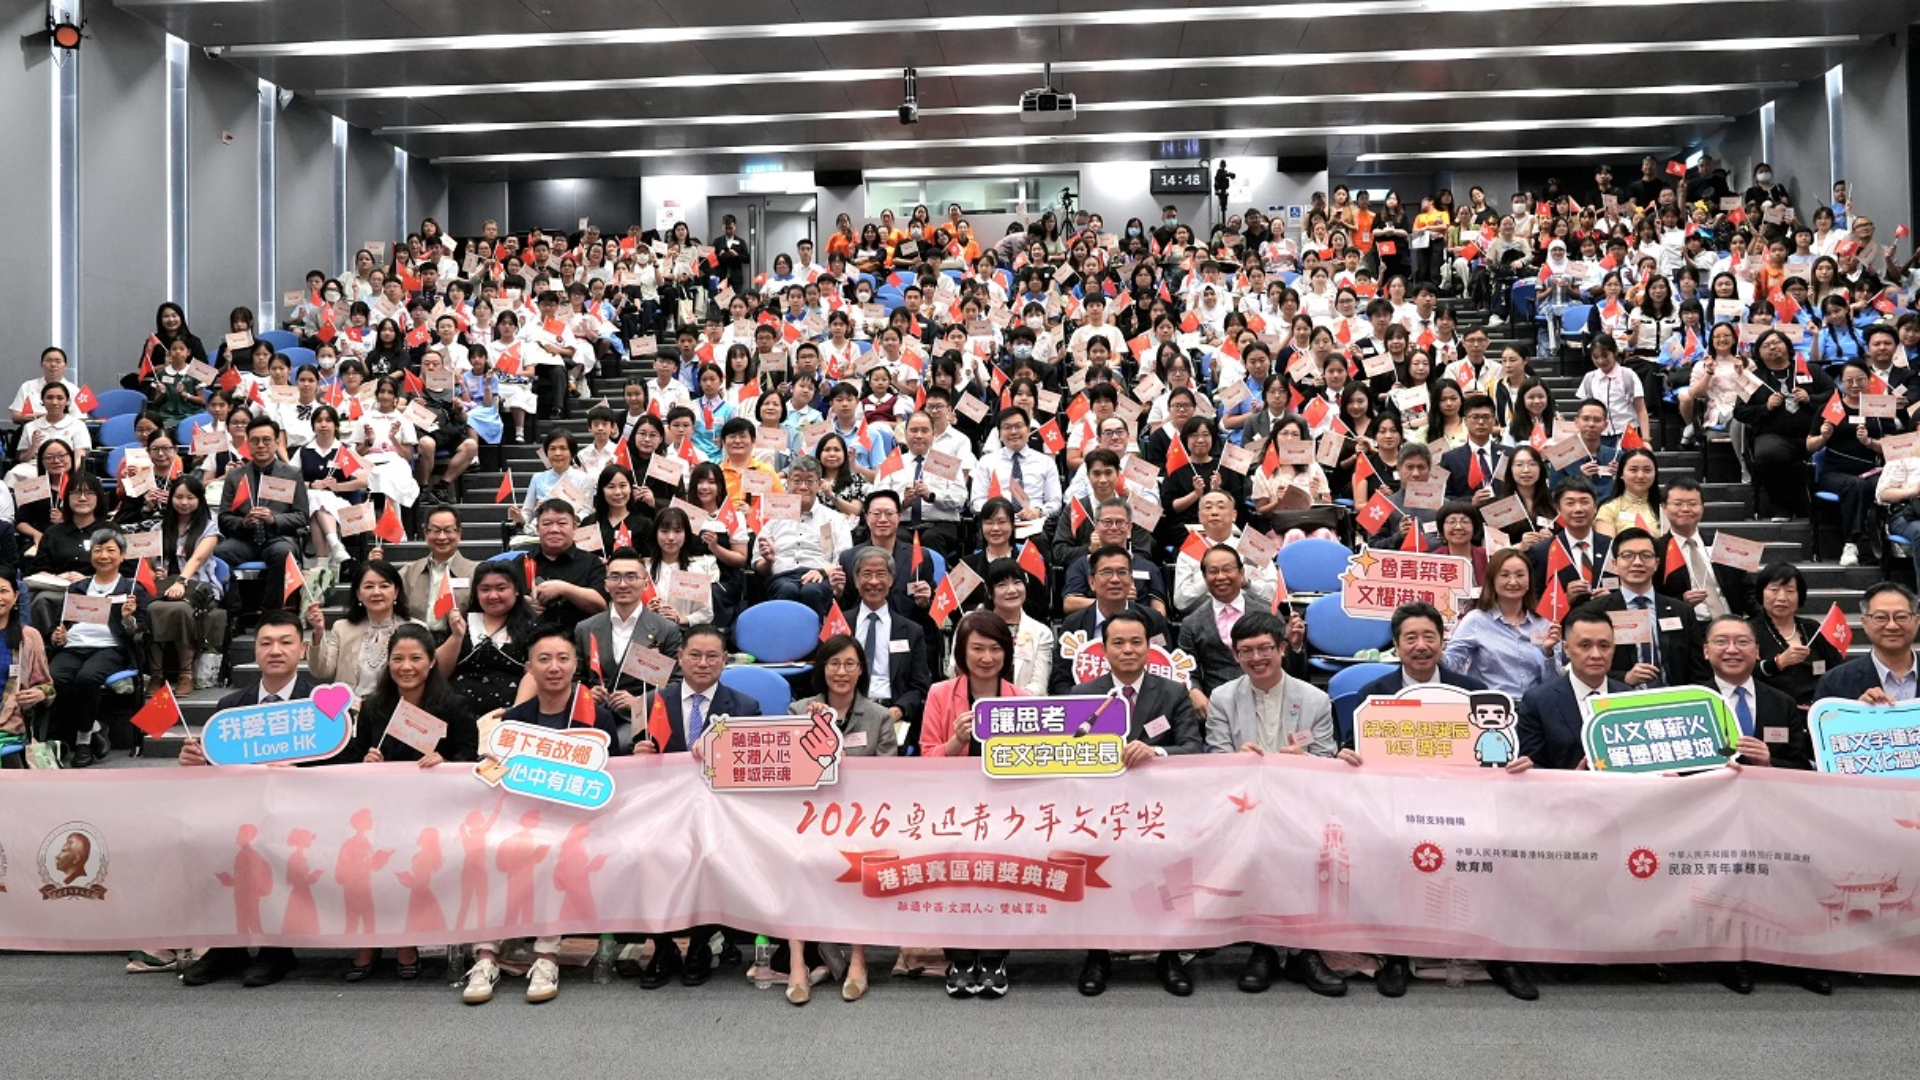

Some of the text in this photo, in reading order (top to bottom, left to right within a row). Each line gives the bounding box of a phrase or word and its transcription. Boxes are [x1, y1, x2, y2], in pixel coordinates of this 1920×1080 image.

[1160, 174, 1201, 186] 14:48
[1380, 557, 1459, 583] 魯青築夢
[218, 707, 316, 742] 我愛香港
[990, 706, 1066, 734] 讓思考
[1363, 720, 1471, 740] 紀念魯迅誕辰
[1601, 714, 1709, 745] 以文傳薪火
[243, 733, 317, 758] I Love HK
[497, 728, 592, 765] 筆下有故鄉
[732, 731, 791, 747] 融通中西
[1384, 738, 1454, 758] 145 週年
[732, 749, 791, 765] 文潤人心
[991, 742, 1119, 767] 在文字中生長
[1607, 737, 1717, 767] 筆墨耀雙城
[508, 762, 605, 800] 心中有遠方
[876, 859, 1069, 892] 港澳賽區頒獎典禮
[1455, 861, 1494, 873] 教育局
[1668, 862, 1770, 876] 民政及青年事務局
